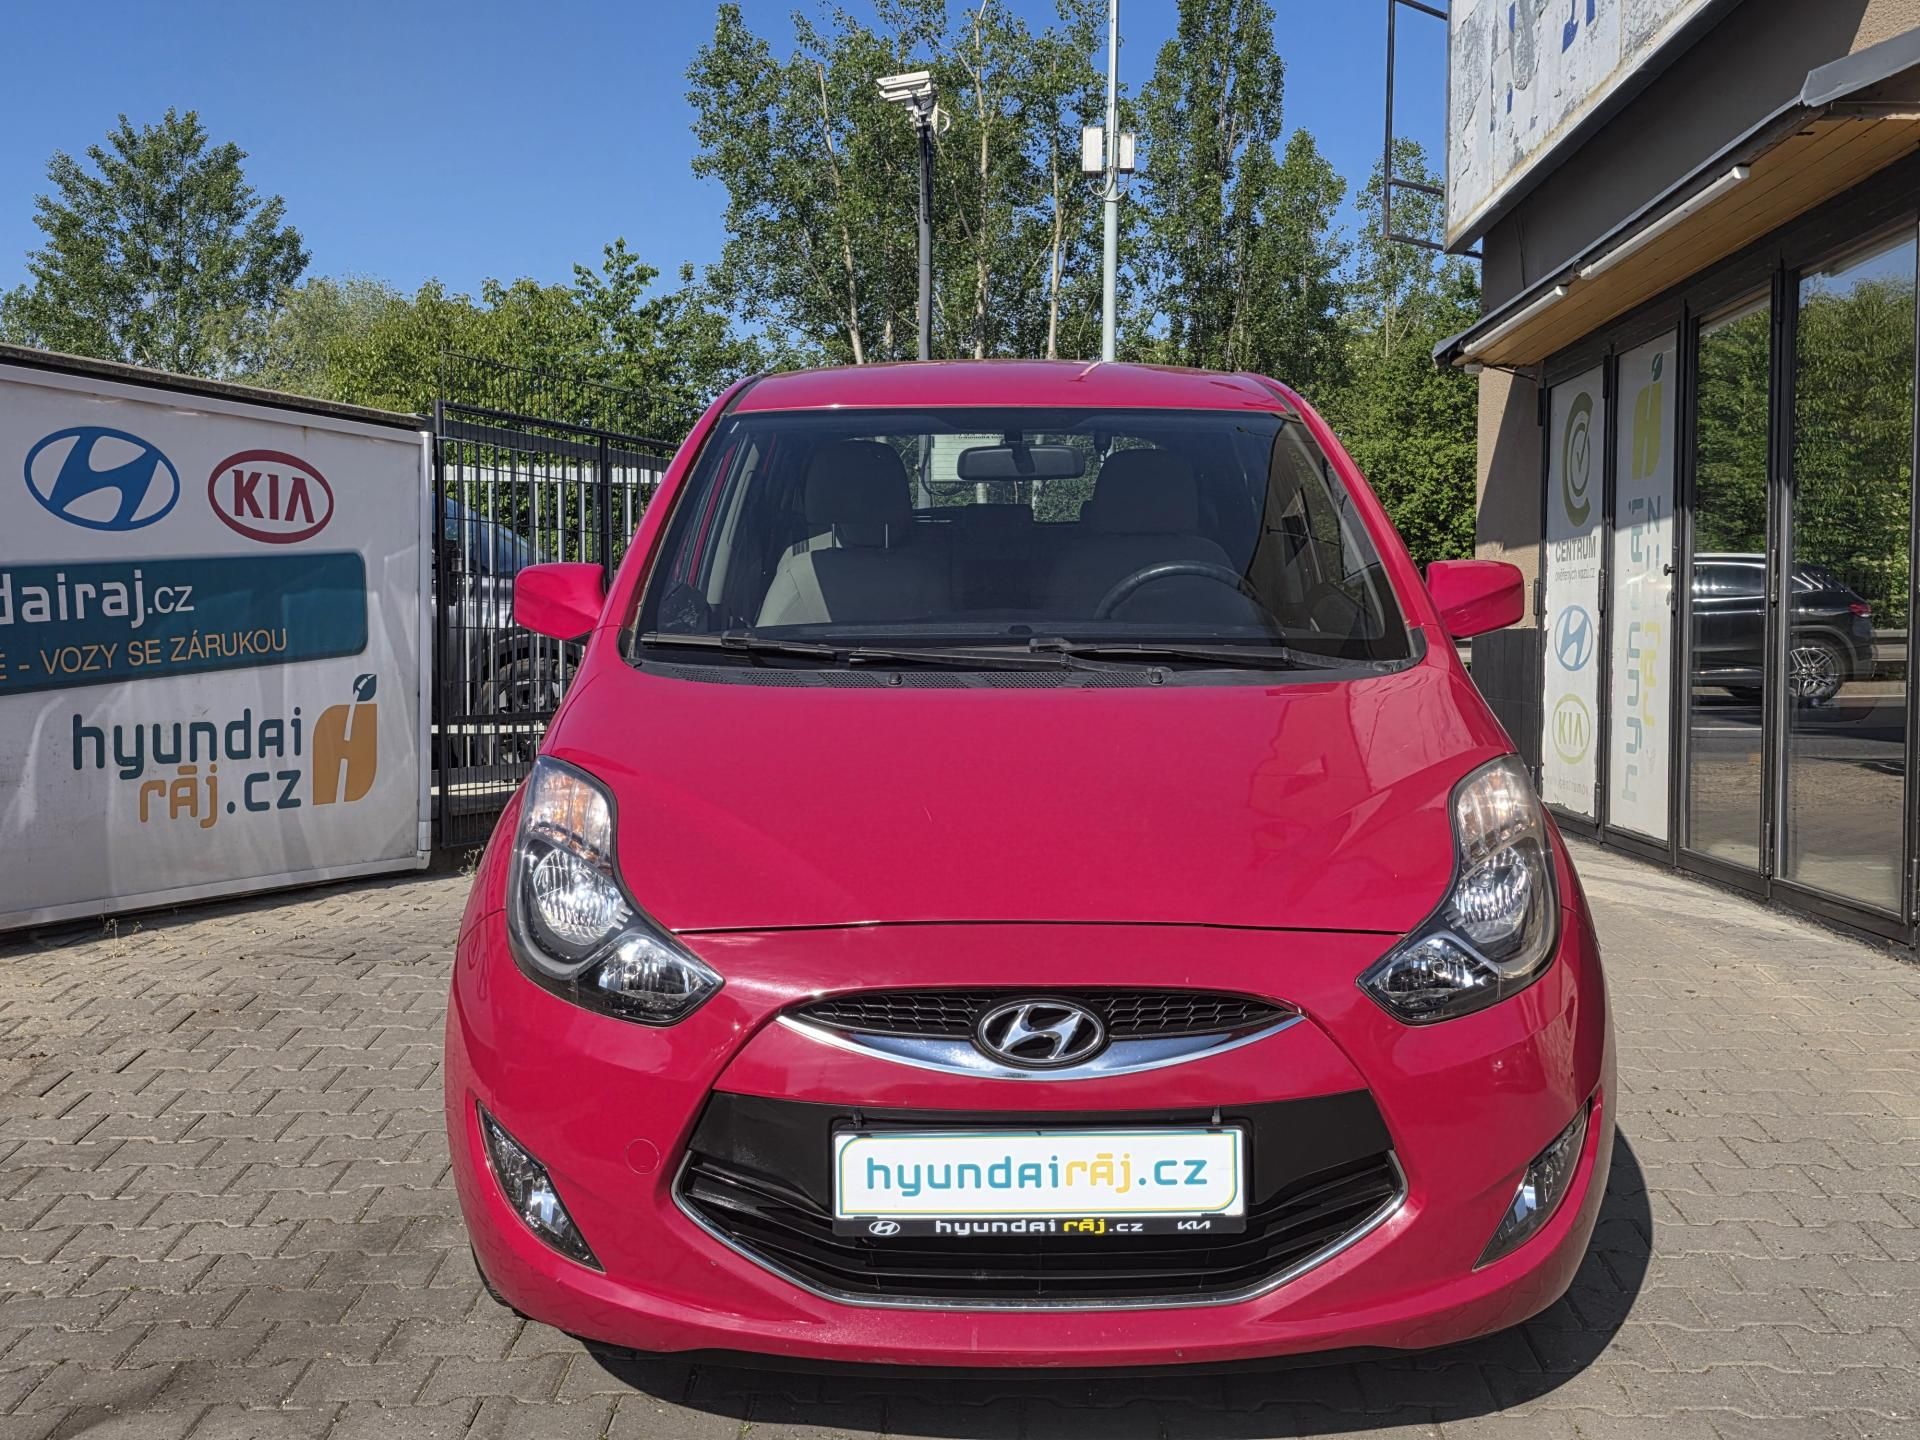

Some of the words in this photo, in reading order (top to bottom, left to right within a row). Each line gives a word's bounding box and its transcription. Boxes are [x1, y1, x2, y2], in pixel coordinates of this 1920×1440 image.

[232, 469, 315, 524] KIA
[1555, 536, 1597, 562] CENTRUM
[40, 643, 119, 676] VOZY
[128, 638, 162, 666] SE
[170, 629, 288, 662] ZÁRUKOU
[73, 706, 302, 780] hyundai
[1558, 711, 1584, 748] KIA
[935, 1219, 1056, 1236] hyundai
